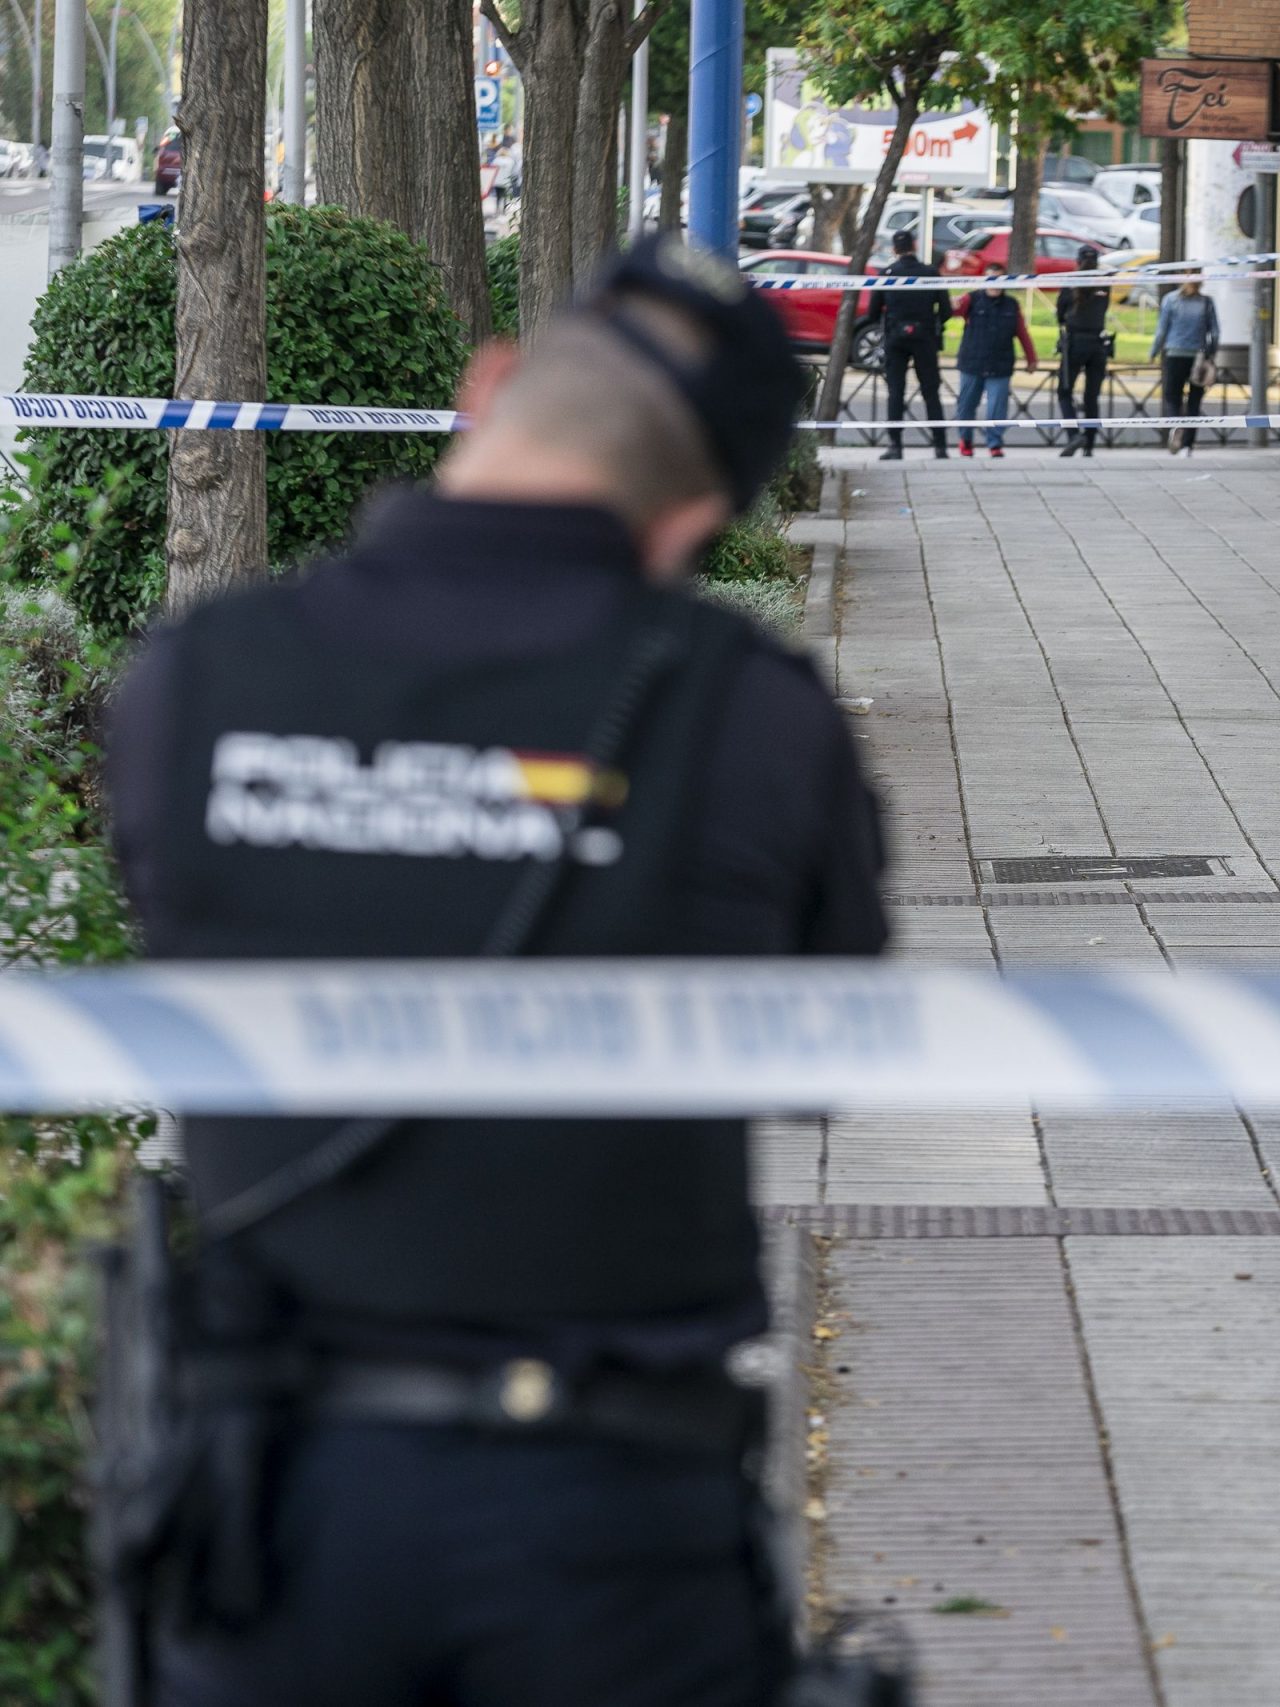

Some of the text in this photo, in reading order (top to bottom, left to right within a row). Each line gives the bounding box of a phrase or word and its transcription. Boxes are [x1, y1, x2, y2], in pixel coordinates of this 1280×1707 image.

[475, 80, 497, 118] P
[882, 129, 952, 158] 50m
[3, 395, 149, 420] POLICIA LOCAL
[302, 408, 440, 425] POLICIA LOCAL
